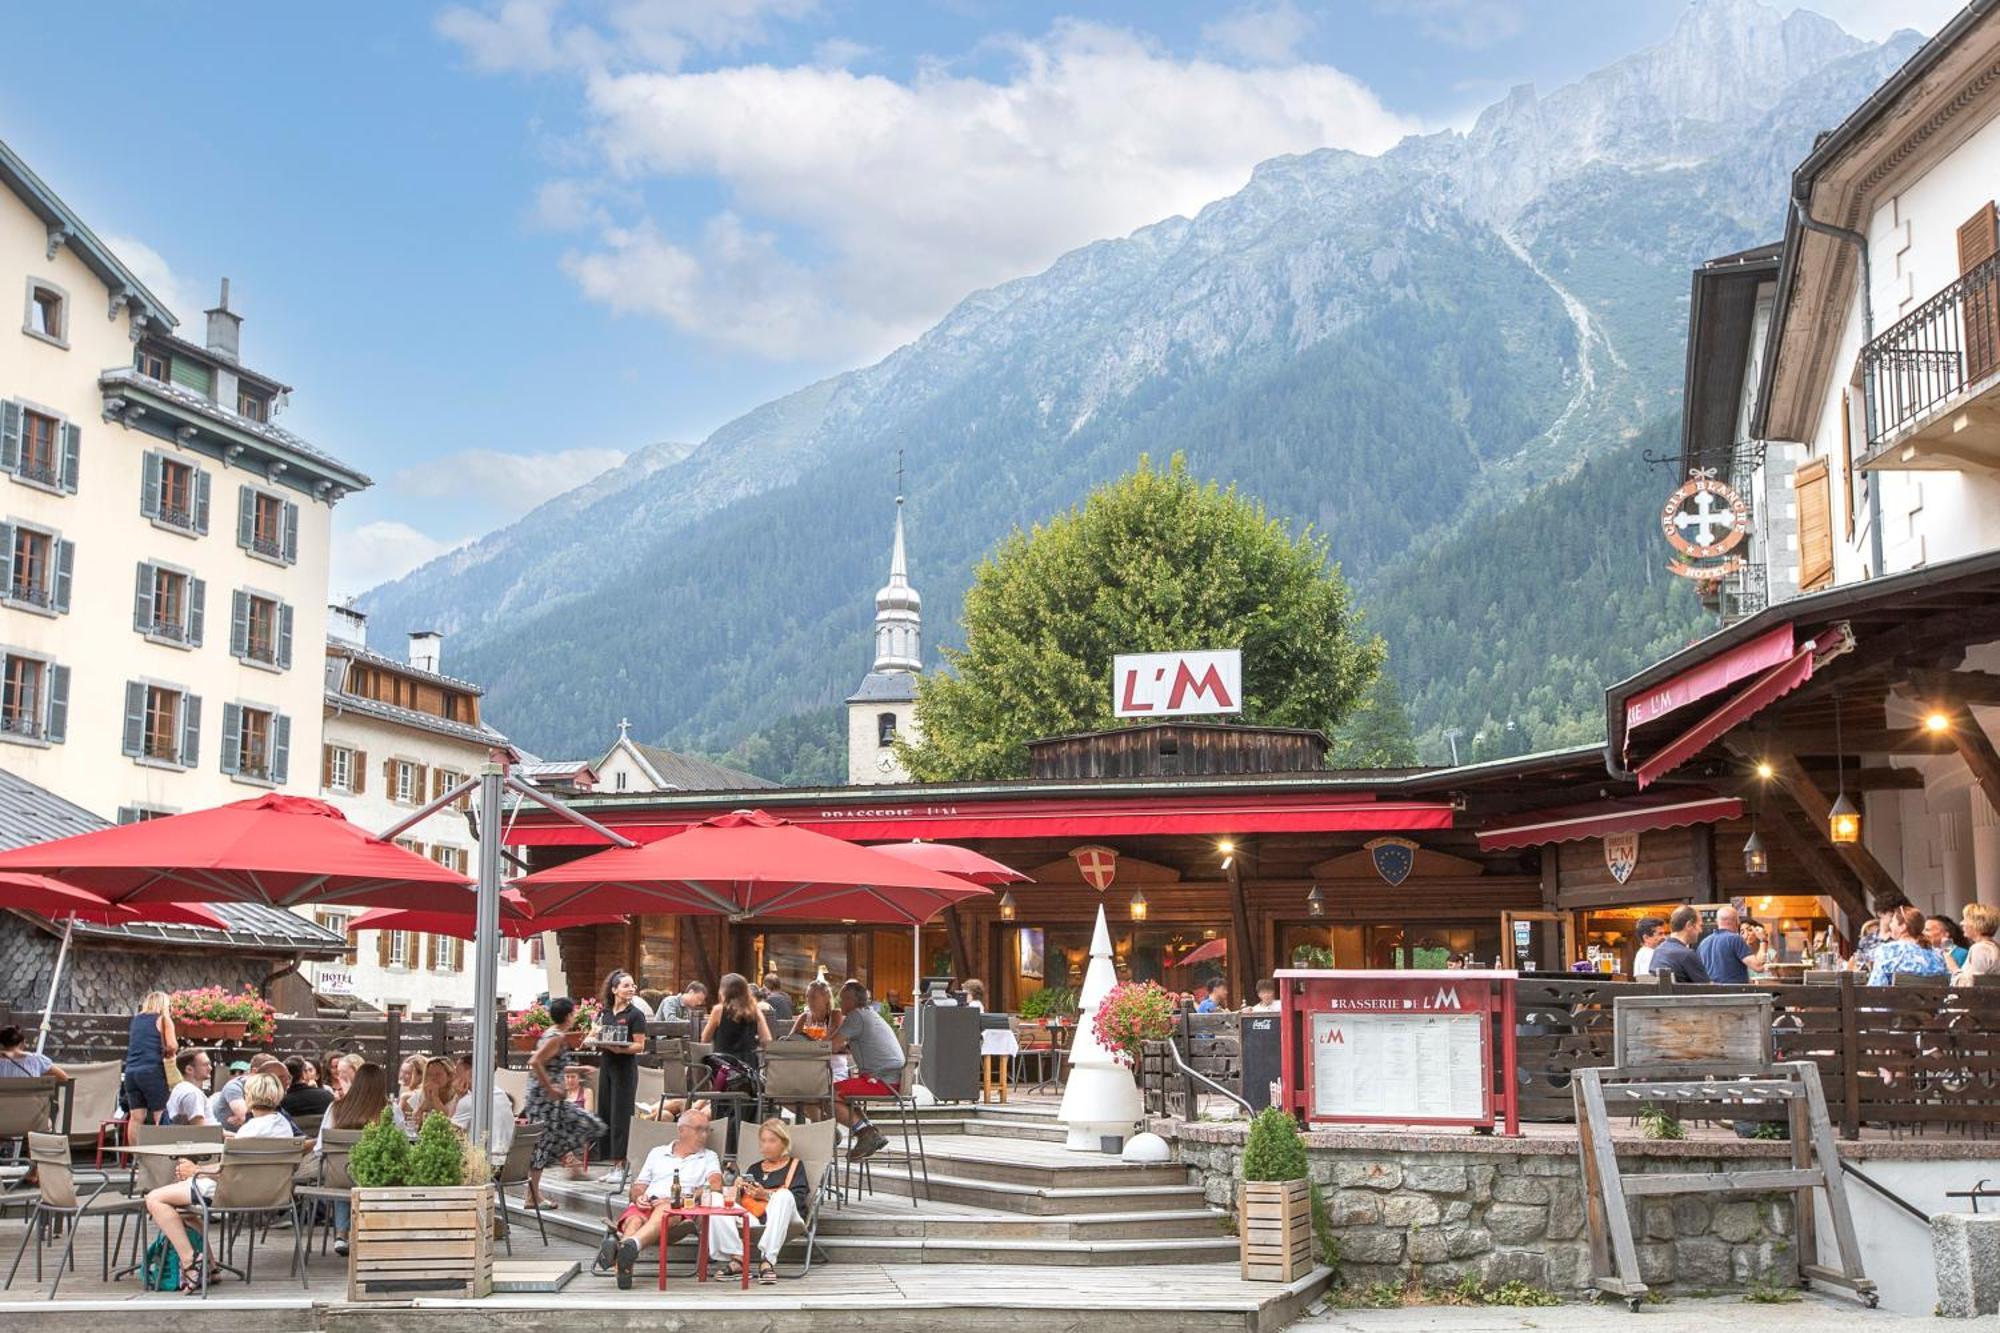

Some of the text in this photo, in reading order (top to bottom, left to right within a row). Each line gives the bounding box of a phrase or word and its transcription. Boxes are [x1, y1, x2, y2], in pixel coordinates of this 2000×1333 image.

[1664, 481, 1746, 536] CROIX BLANCHE
[1121, 658, 1234, 712] L'M
[1331, 999, 1400, 1009] BRASSERIE
[1423, 986, 1461, 1009] L'M
